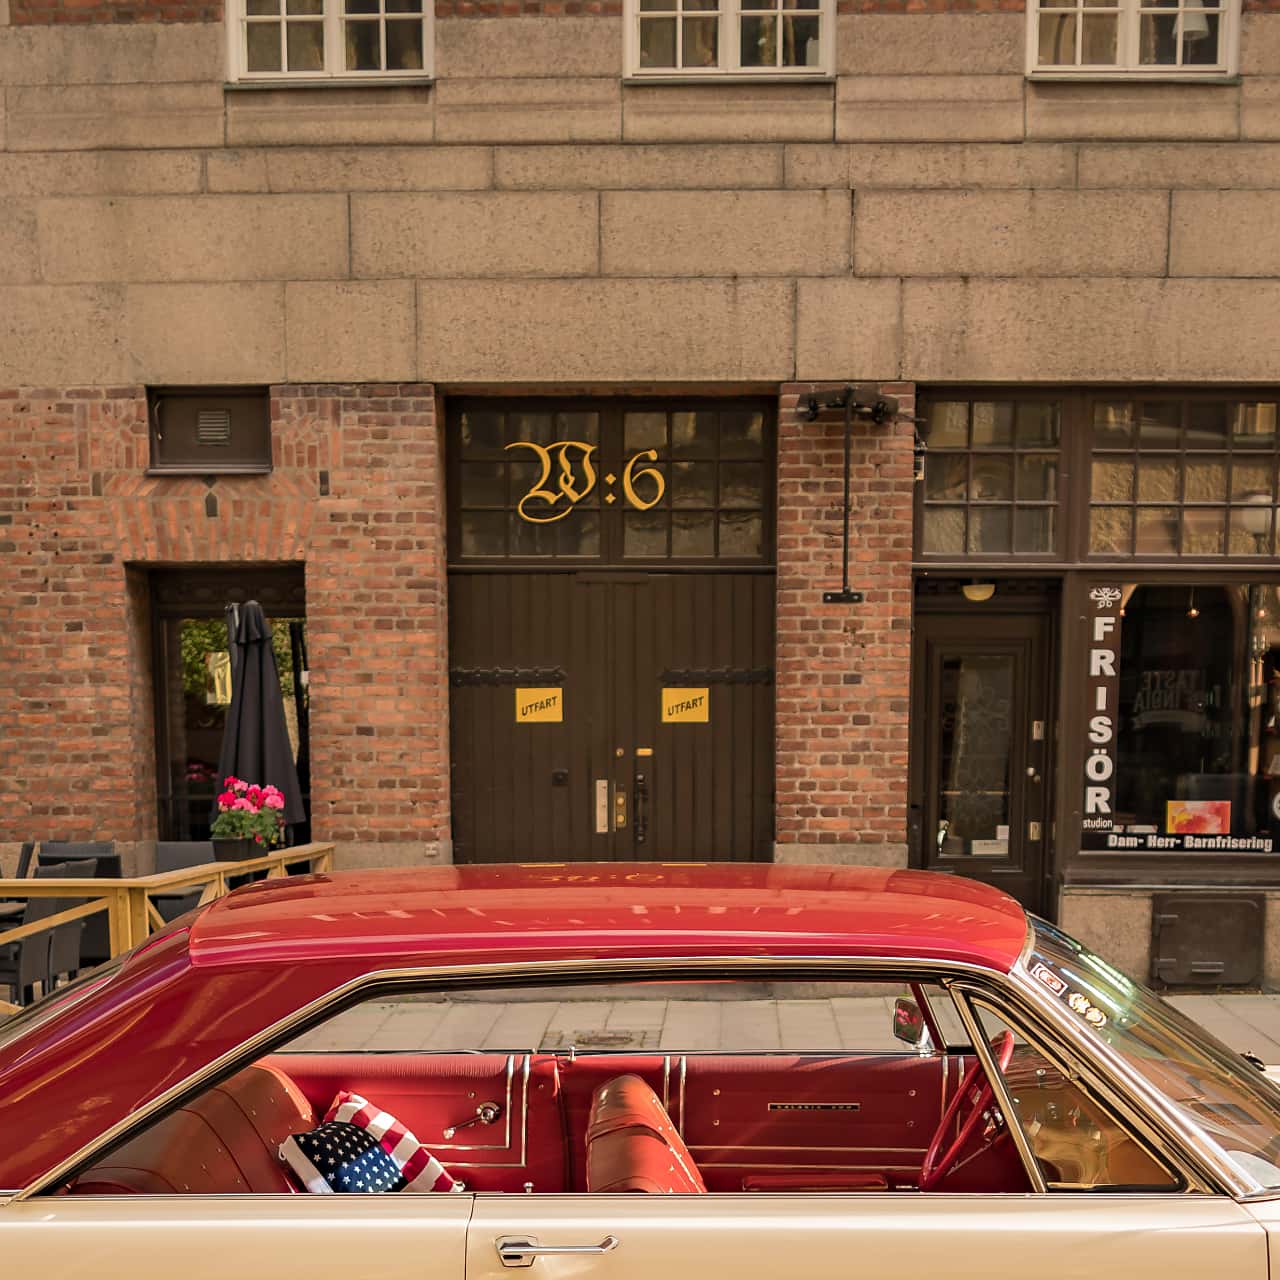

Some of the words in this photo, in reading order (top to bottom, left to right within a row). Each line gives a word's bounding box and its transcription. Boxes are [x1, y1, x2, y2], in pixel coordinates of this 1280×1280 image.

[521, 696, 558, 716] UTFART
[667, 696, 705, 716] UTFART
[1084, 616, 1116, 813] FRISÖR
[1082, 818, 1113, 829] studion
[1107, 834, 1144, 848] Dam-
[1147, 834, 1181, 849] Herr-
[1184, 835, 1272, 852] Barnfrisering
